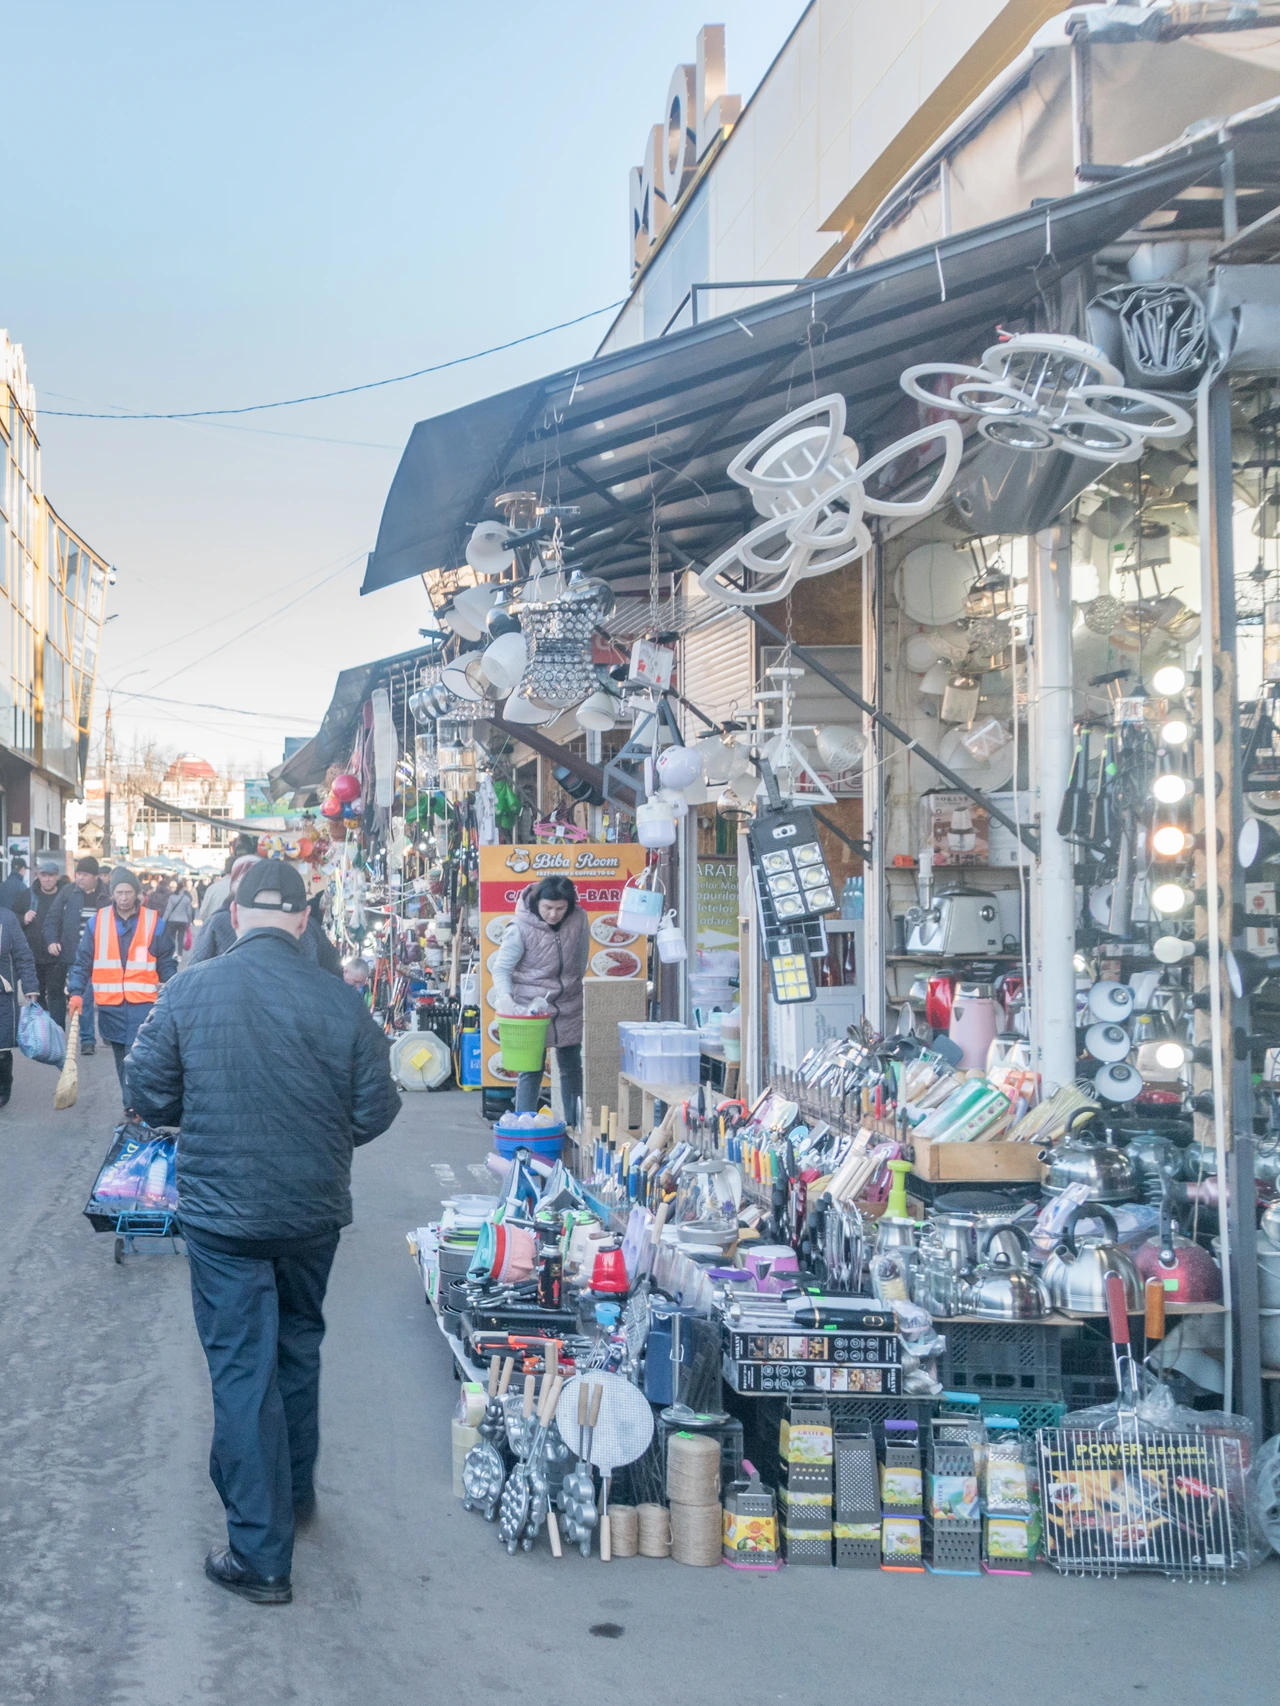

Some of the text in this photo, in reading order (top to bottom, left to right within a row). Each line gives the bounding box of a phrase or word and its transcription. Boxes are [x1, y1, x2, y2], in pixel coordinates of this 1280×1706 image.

[532, 852, 620, 870] Biba Room
[1076, 1443, 1145, 1457] POWER
